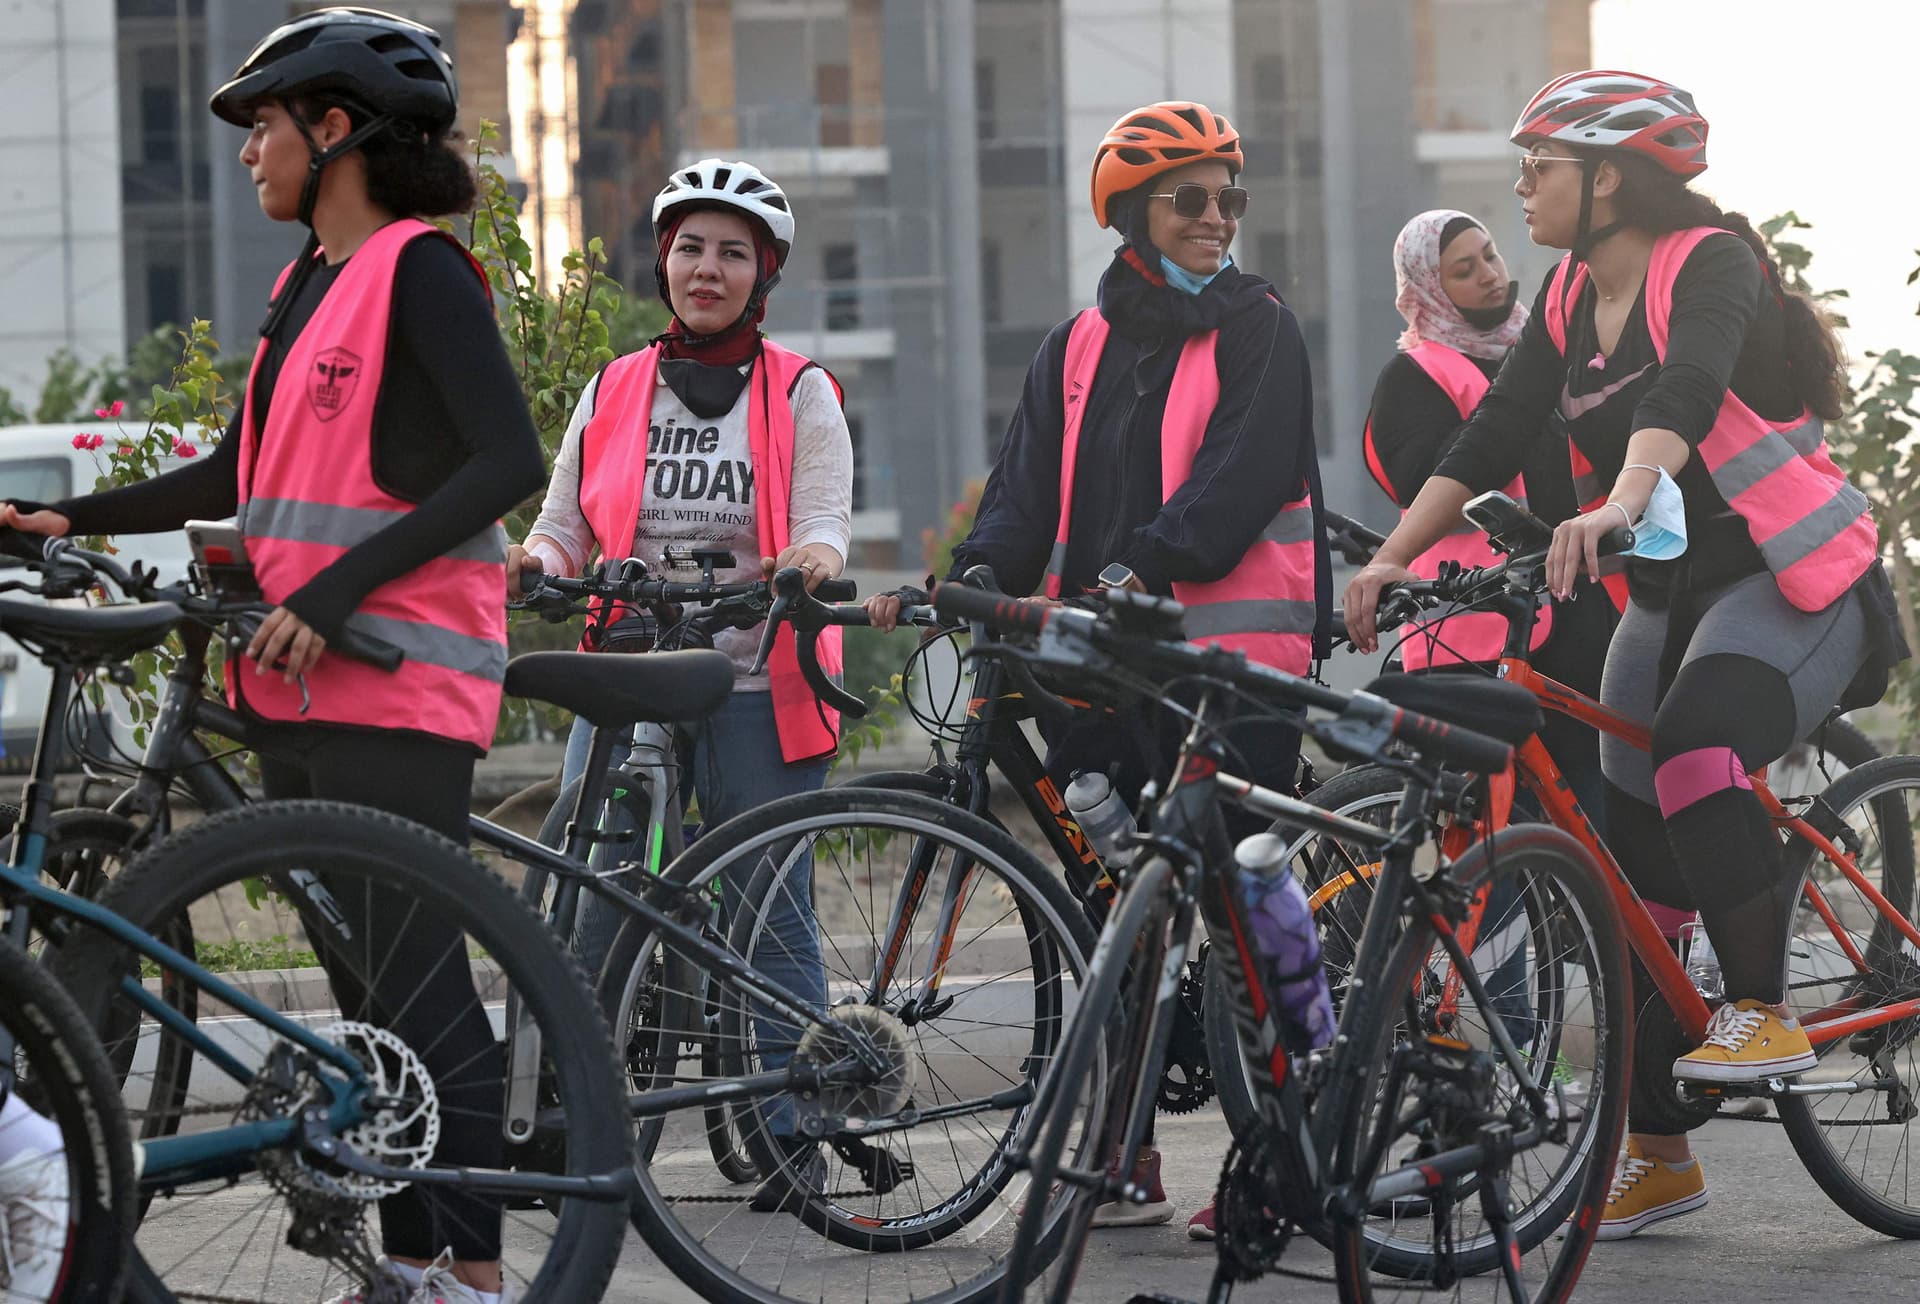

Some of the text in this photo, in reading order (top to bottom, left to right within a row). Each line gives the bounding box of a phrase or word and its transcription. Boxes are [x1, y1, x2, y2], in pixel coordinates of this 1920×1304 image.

[645, 458, 754, 504] TODAY
[638, 508, 752, 526] GIRL WITH MIND
[674, 531, 697, 541] with
[882, 1190, 974, 1229] CHARIOT
